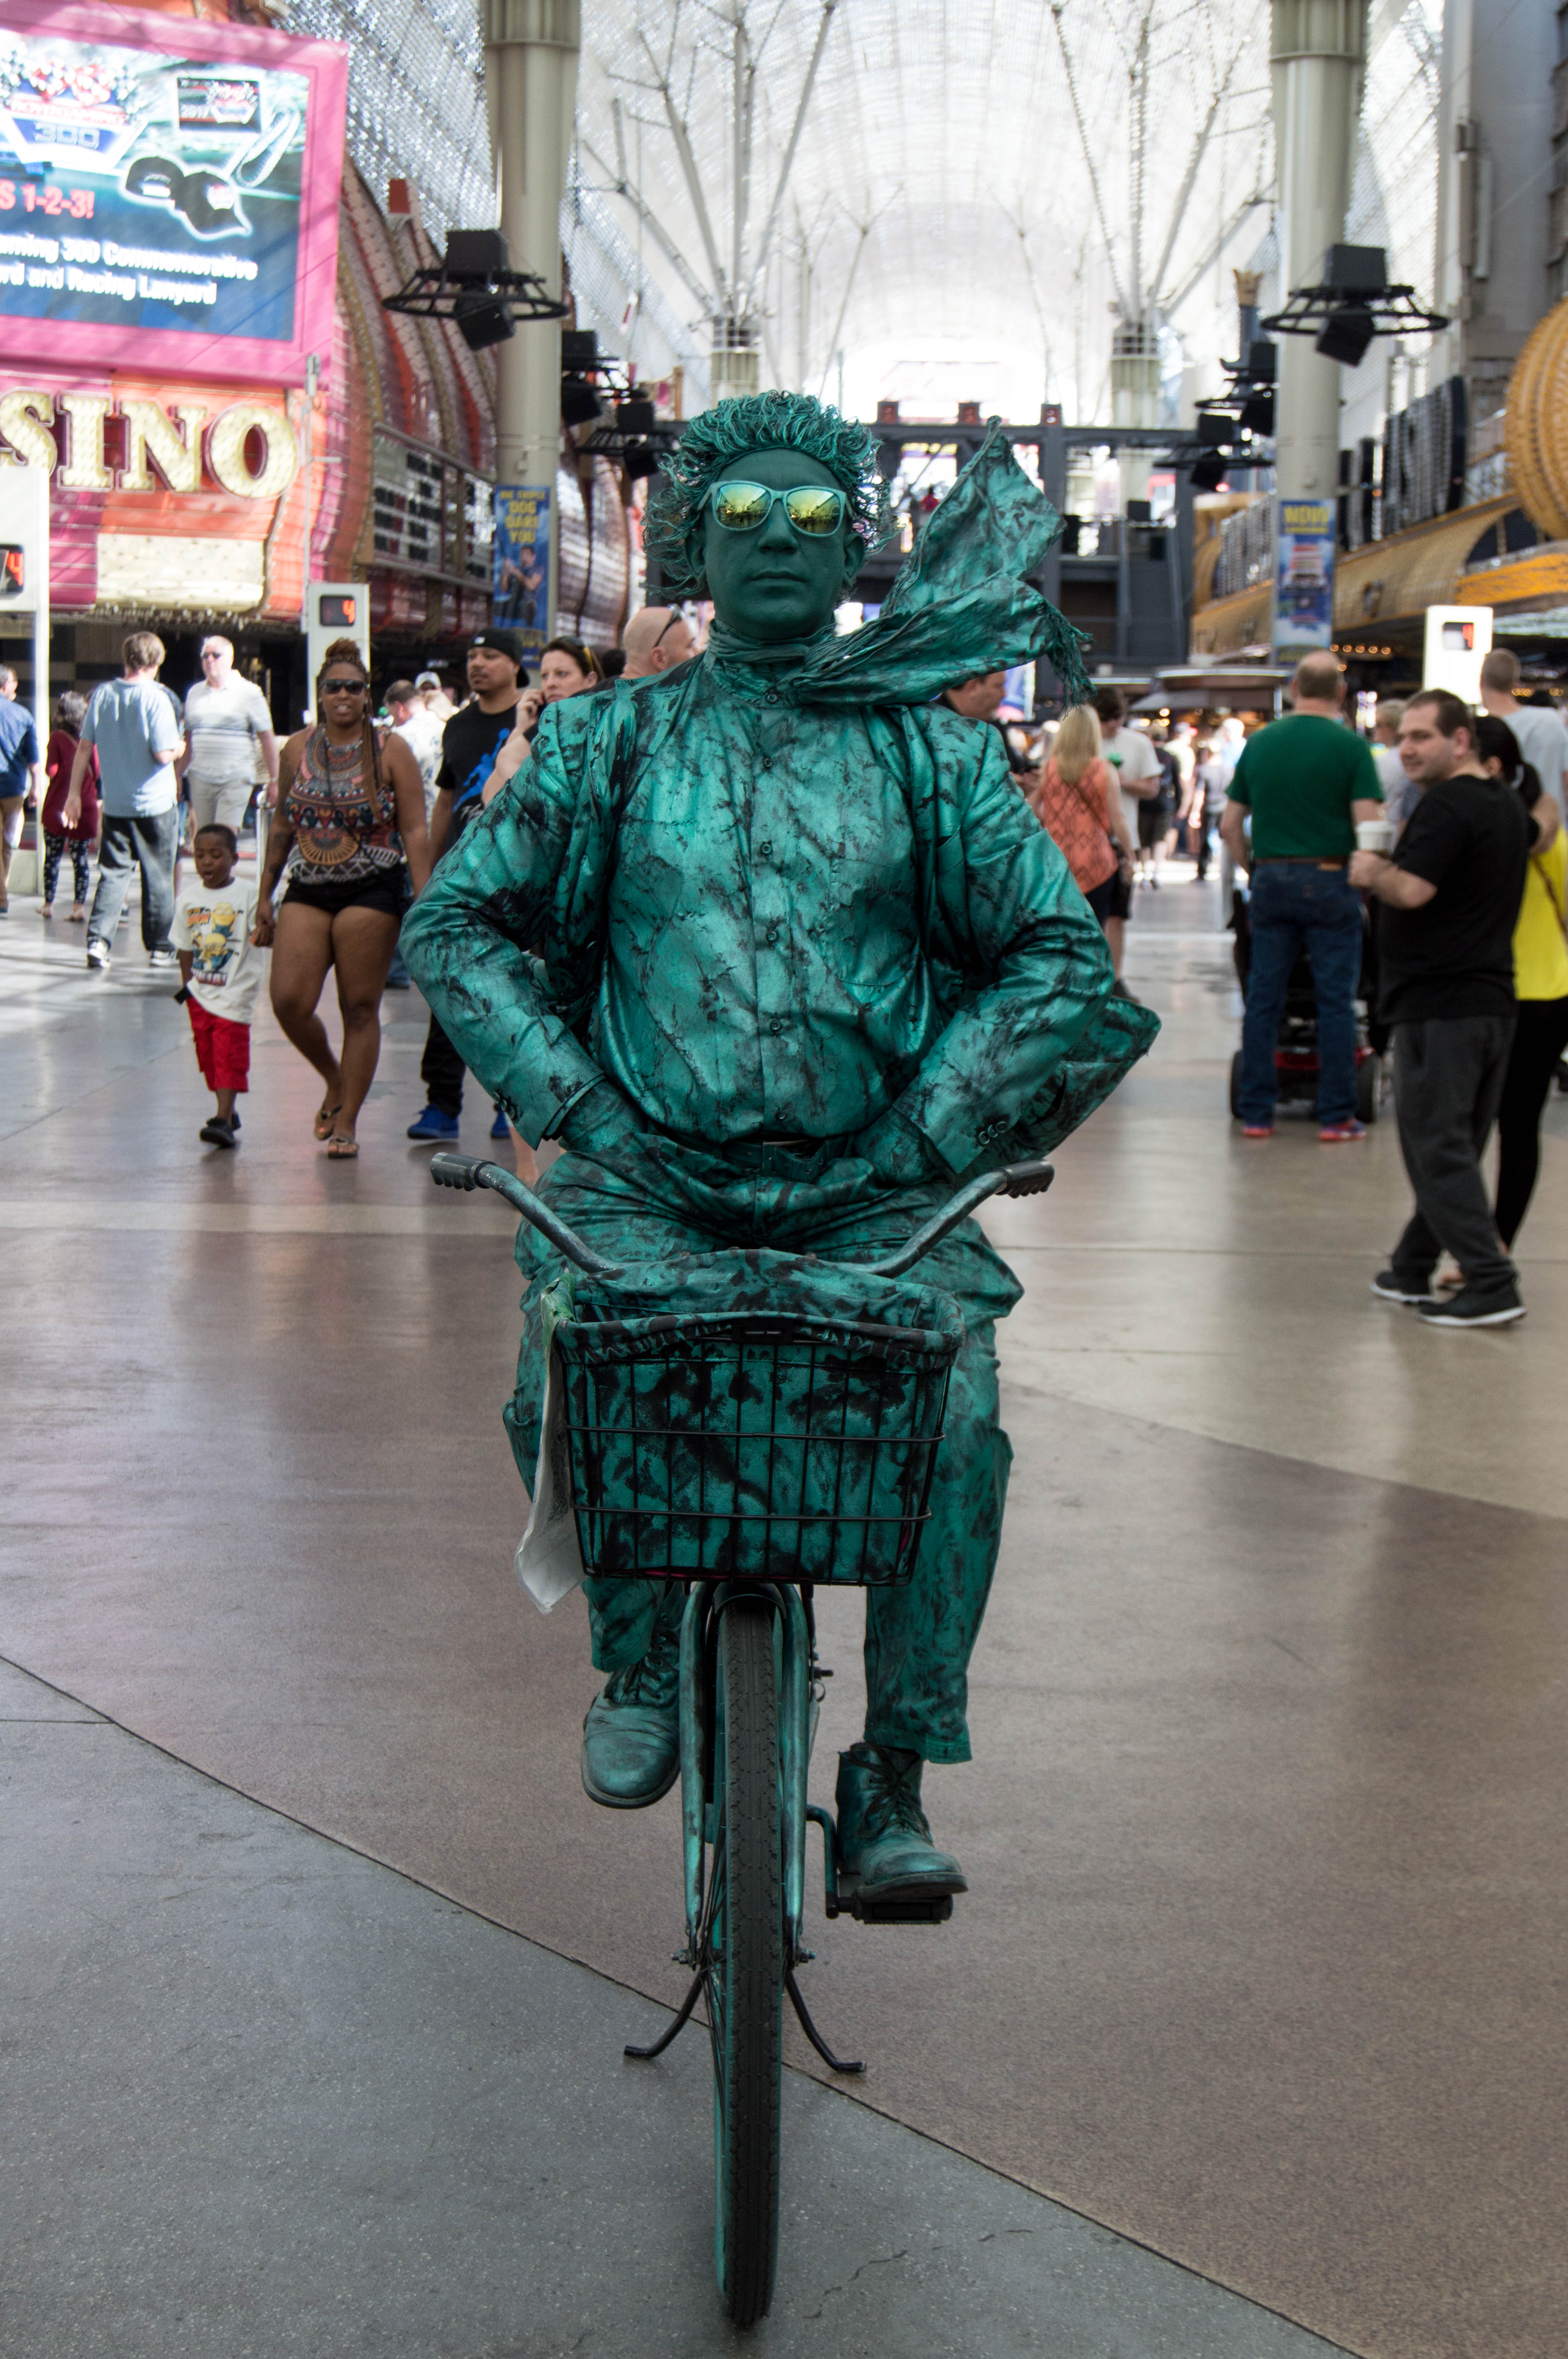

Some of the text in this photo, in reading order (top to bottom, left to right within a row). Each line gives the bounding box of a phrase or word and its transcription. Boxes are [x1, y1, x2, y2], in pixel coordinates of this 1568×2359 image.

[34, 121, 100, 151] 300
[22, 183, 95, 219] 1-2-3!
[62, 236, 100, 264] 300
[103, 241, 258, 280] Commemorative
[27, 267, 64, 289] and
[68, 267, 136, 301] Racing
[139, 274, 217, 305] Lanyard
[0, 386, 300, 500] SINO
[1284, 506, 1330, 523] NOW
[510, 530, 535, 543] YOU
